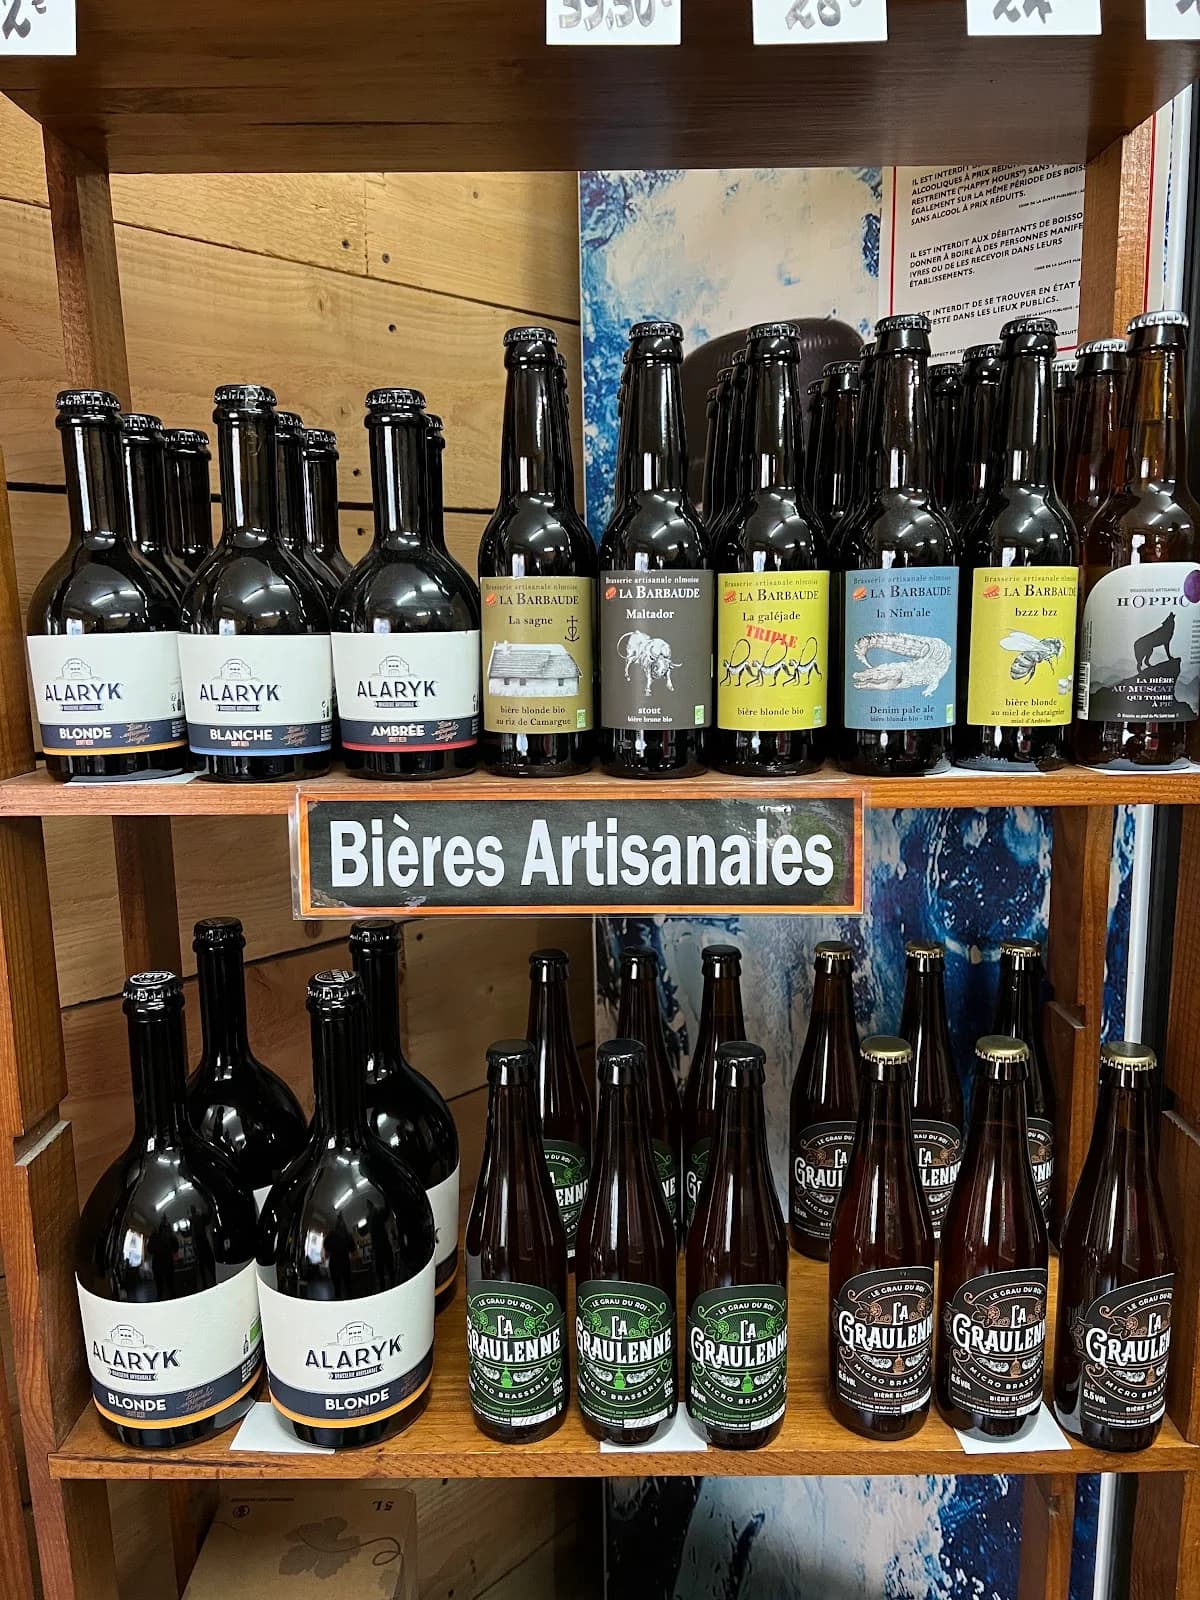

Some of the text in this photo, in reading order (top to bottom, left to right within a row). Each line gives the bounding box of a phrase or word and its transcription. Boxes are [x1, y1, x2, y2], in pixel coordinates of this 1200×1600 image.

[912, 176, 963, 196] ALCOOLIQUES
[972, 168, 990, 180] PRIX
[920, 174, 932, 185] EST
[934, 165, 969, 181] INTERDIT
[912, 197, 955, 216] ÉGALEMENT
[957, 194, 973, 204] SUR
[974, 190, 984, 200] LA
[986, 184, 1009, 198] MÊME
[1010, 175, 1045, 192] PÉRIODE
[1046, 171, 1062, 182] DES
[912, 188, 957, 206] RESTREINTE
[911, 215, 930, 226] SANS
[931, 207, 961, 221] ALCOOL
[970, 200, 989, 211] PRIX
[990, 190, 1027, 205] RÉDUITS.
[910, 250, 918, 259] IL
[919, 247, 931, 258] EST
[933, 238, 969, 254] INTERDIT
[971, 234, 989, 245] AUX
[991, 222, 1038, 241] DÉBITANTS
[1039, 218, 1051, 228] DE
[909, 236, 1063, 279] IVRES OU DE LES RECEVOIR DANS LEURS
[910, 255, 942, 269] DONNER
[950, 247, 974, 260] BOIRE
[983, 242, 998, 252] DES
[1000, 230, 1049, 248] PERSONNES
[909, 268, 976, 288] ÉTABLISSEMENTS.
[932, 302, 969, 317] INTERDIT
[972, 299, 983, 309] DE
[984, 297, 994, 306] SE
[996, 289, 1036, 304] TROUVER
[1038, 286, 1051, 295] EN
[1053, 280, 1076, 292] ÉTAT
[953, 311, 975, 322] DANS
[977, 307, 991, 318] LES
[992, 302, 1018, 315] LIEUX
[1020, 294, 1059, 310] PUBLICS.
[500, 592, 579, 606] LA BARBAUDE
[619, 585, 700, 600] LA BARBAUDE
[739, 589, 819, 603] LA BARBAUDE
[870, 585, 952, 599] LA BARBAUDE
[1004, 587, 1021, 597] LA
[626, 609, 675, 619] Maltador
[742, 610, 801, 624] La galéjade
[877, 609, 886, 619] la
[1015, 607, 1058, 617] bzzz bzz
[509, 616, 553, 628] La sagne
[745, 624, 798, 649] TRIPLE
[46, 682, 122, 701] ALARYK
[200, 684, 280, 701] ALARYK
[357, 680, 436, 697] ALARYK
[1112, 685, 1173, 693] AU MUSCAT
[1005, 696, 1057, 706] bière blonde
[1127, 694, 1142, 702] QUI
[500, 704, 566, 714] bière blonde bio
[638, 706, 661, 714] stout
[737, 705, 804, 716] bière blonde bio
[869, 704, 934, 717] Denim pale ale
[1002, 708, 1020, 716] miel
[1021, 707, 1030, 716] de
[371, 723, 426, 737] AMBRÉE
[505, 717, 515, 726] riz
[517, 717, 528, 726] de
[530, 716, 572, 728] Camargue
[59, 726, 112, 740] BLONDE
[210, 728, 273, 741] BLANCHE
[329, 813, 835, 888] Bières Artisanales
[870, 1289, 880, 1298] LE
[880, 1284, 902, 1294] GRAU
[591, 1299, 600, 1308] LE
[599, 1298, 620, 1306] GRAU
[622, 1299, 634, 1307] DU
[717, 1306, 727, 1315] LE
[727, 1302, 750, 1312] GRAU
[892, 1301, 908, 1326] LA
[1010, 1304, 1026, 1329] LA
[497, 1314, 514, 1339] LA
[611, 1315, 628, 1340] LA
[740, 1319, 756, 1344] LA
[1147, 1312, 1161, 1338] LA
[93, 1340, 181, 1371] ALARYK
[305, 1334, 402, 1369] ALARYK
[853, 1363, 885, 1385] MICRO
[583, 1371, 662, 1401] MICRO BRASSERIE
[704, 1379, 734, 1403] MICRO
[107, 1392, 167, 1412] BLONDE
[325, 1387, 390, 1411] BLONDE
